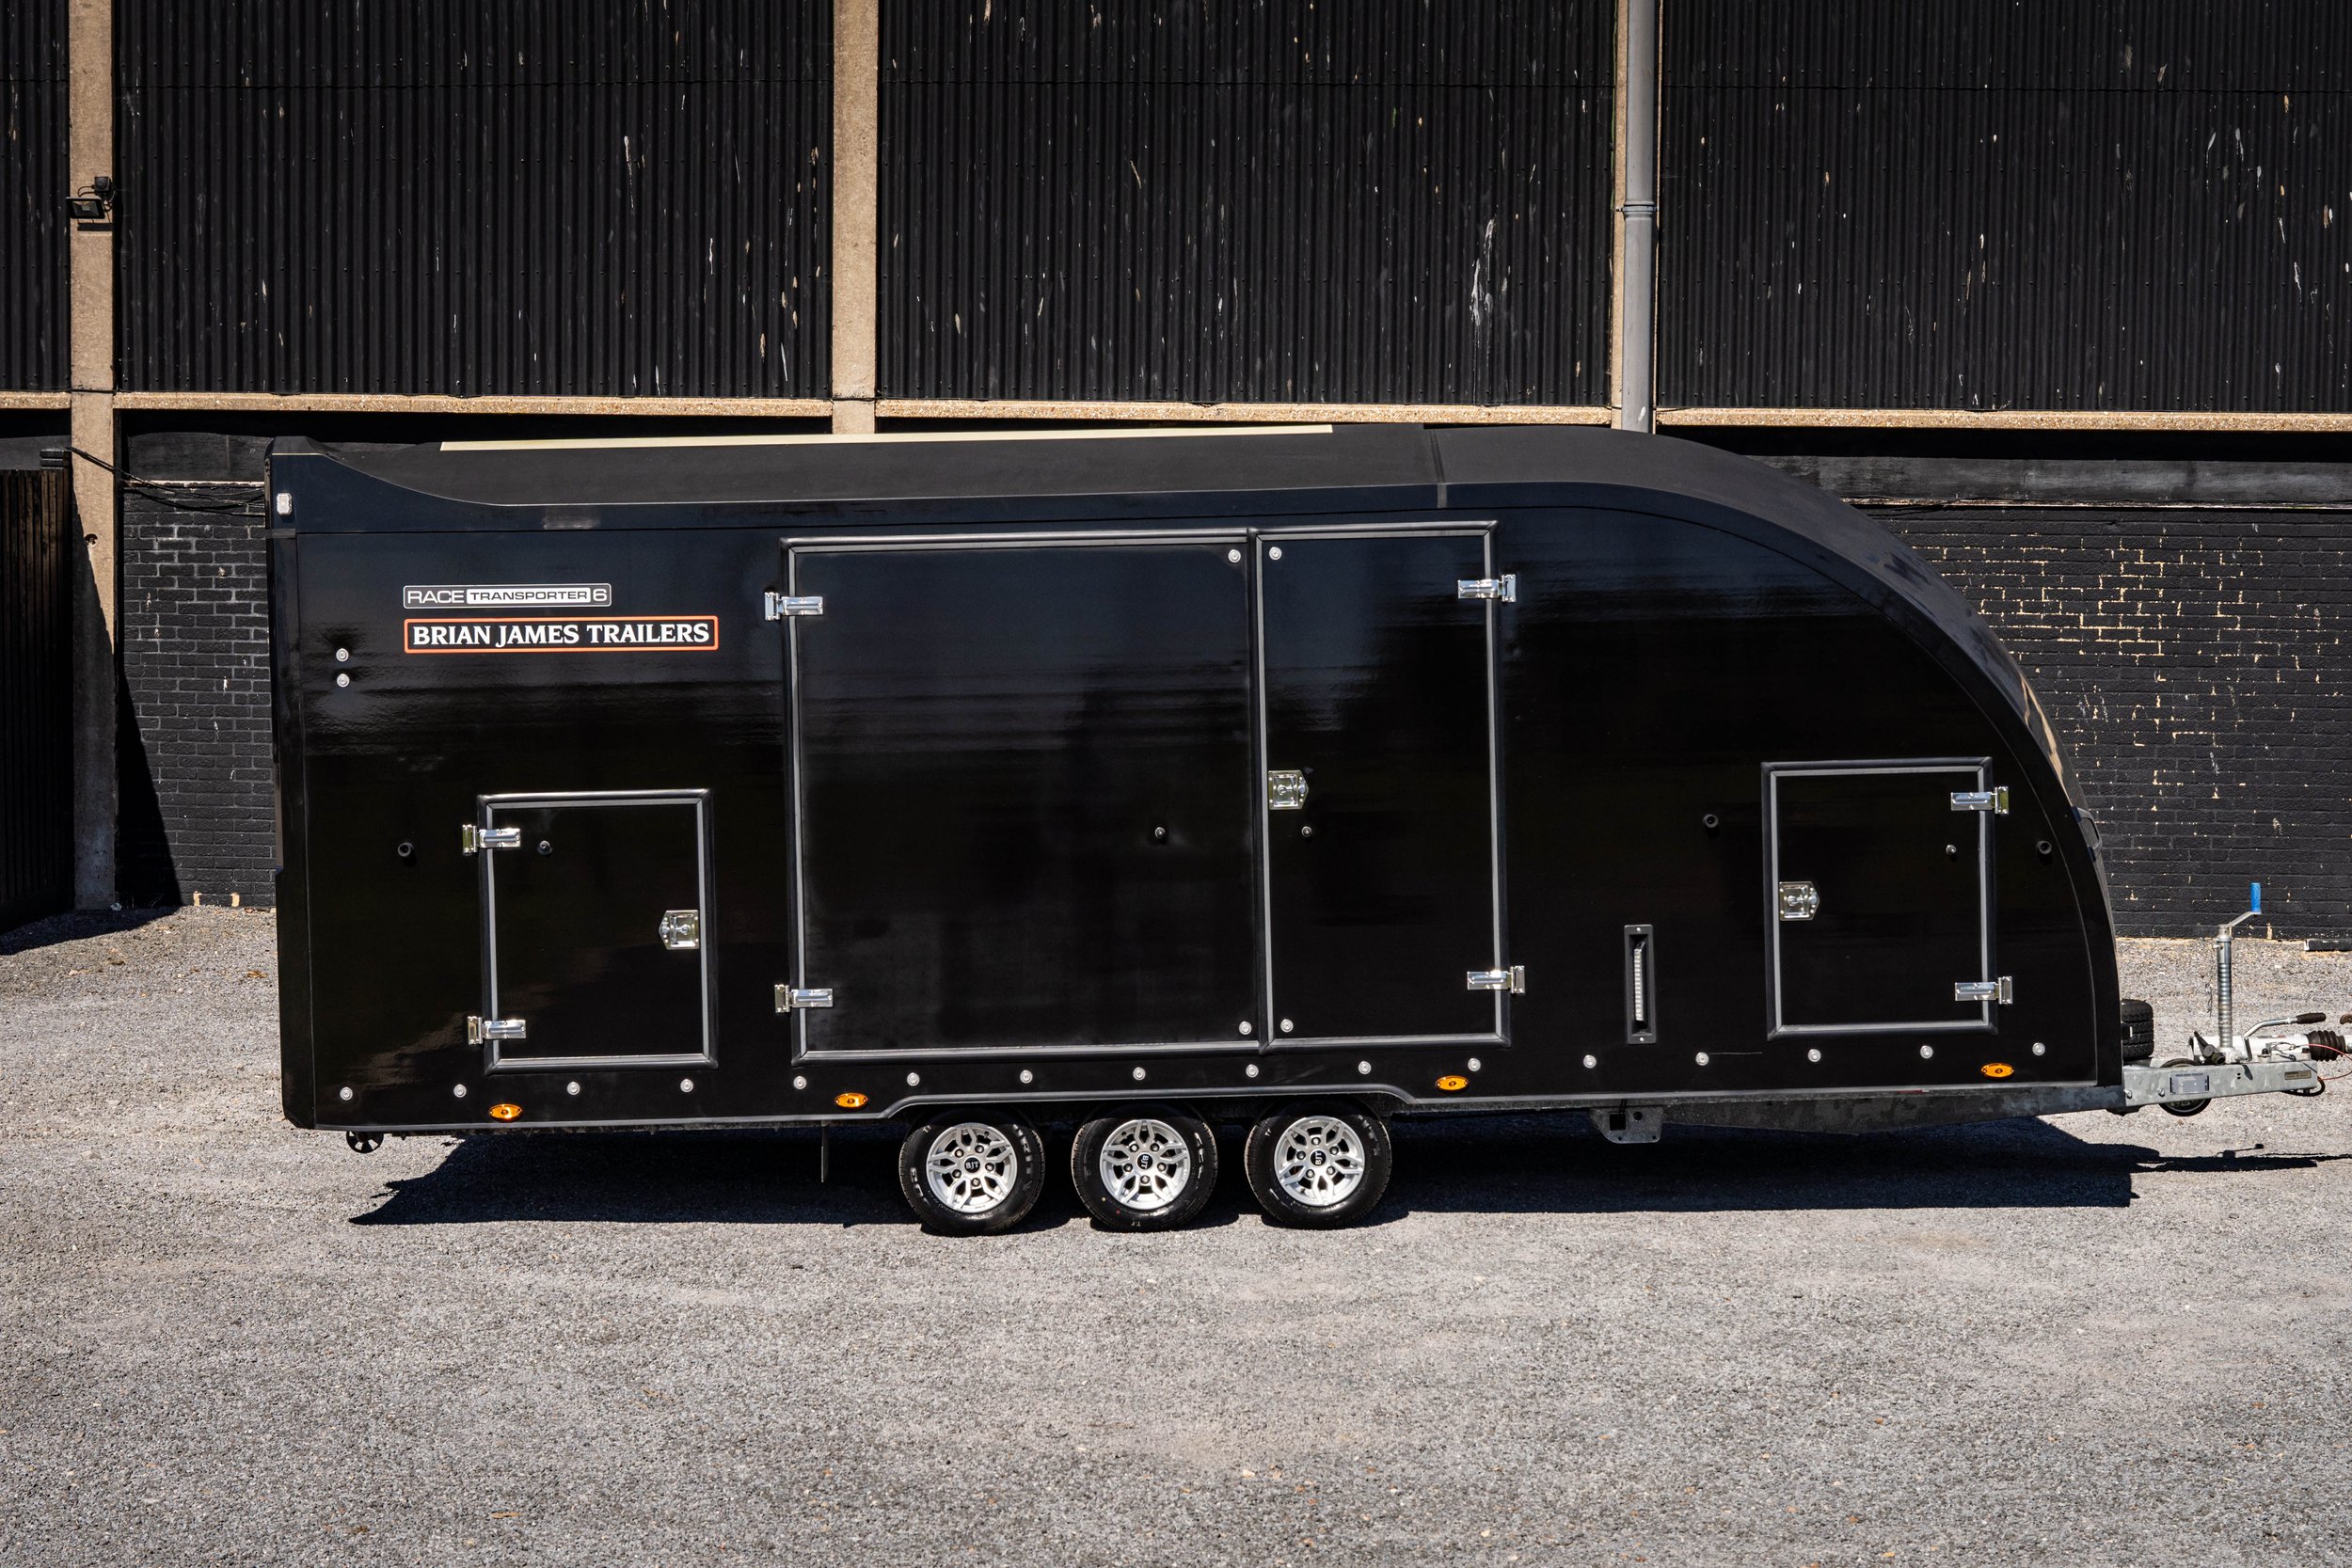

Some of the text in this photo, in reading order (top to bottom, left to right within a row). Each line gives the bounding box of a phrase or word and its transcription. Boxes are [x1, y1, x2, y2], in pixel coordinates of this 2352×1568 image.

[407, 588, 608, 604] RACE TRANSPORTER 6
[413, 623, 709, 648] BRIAN JAMES TRAILERS
